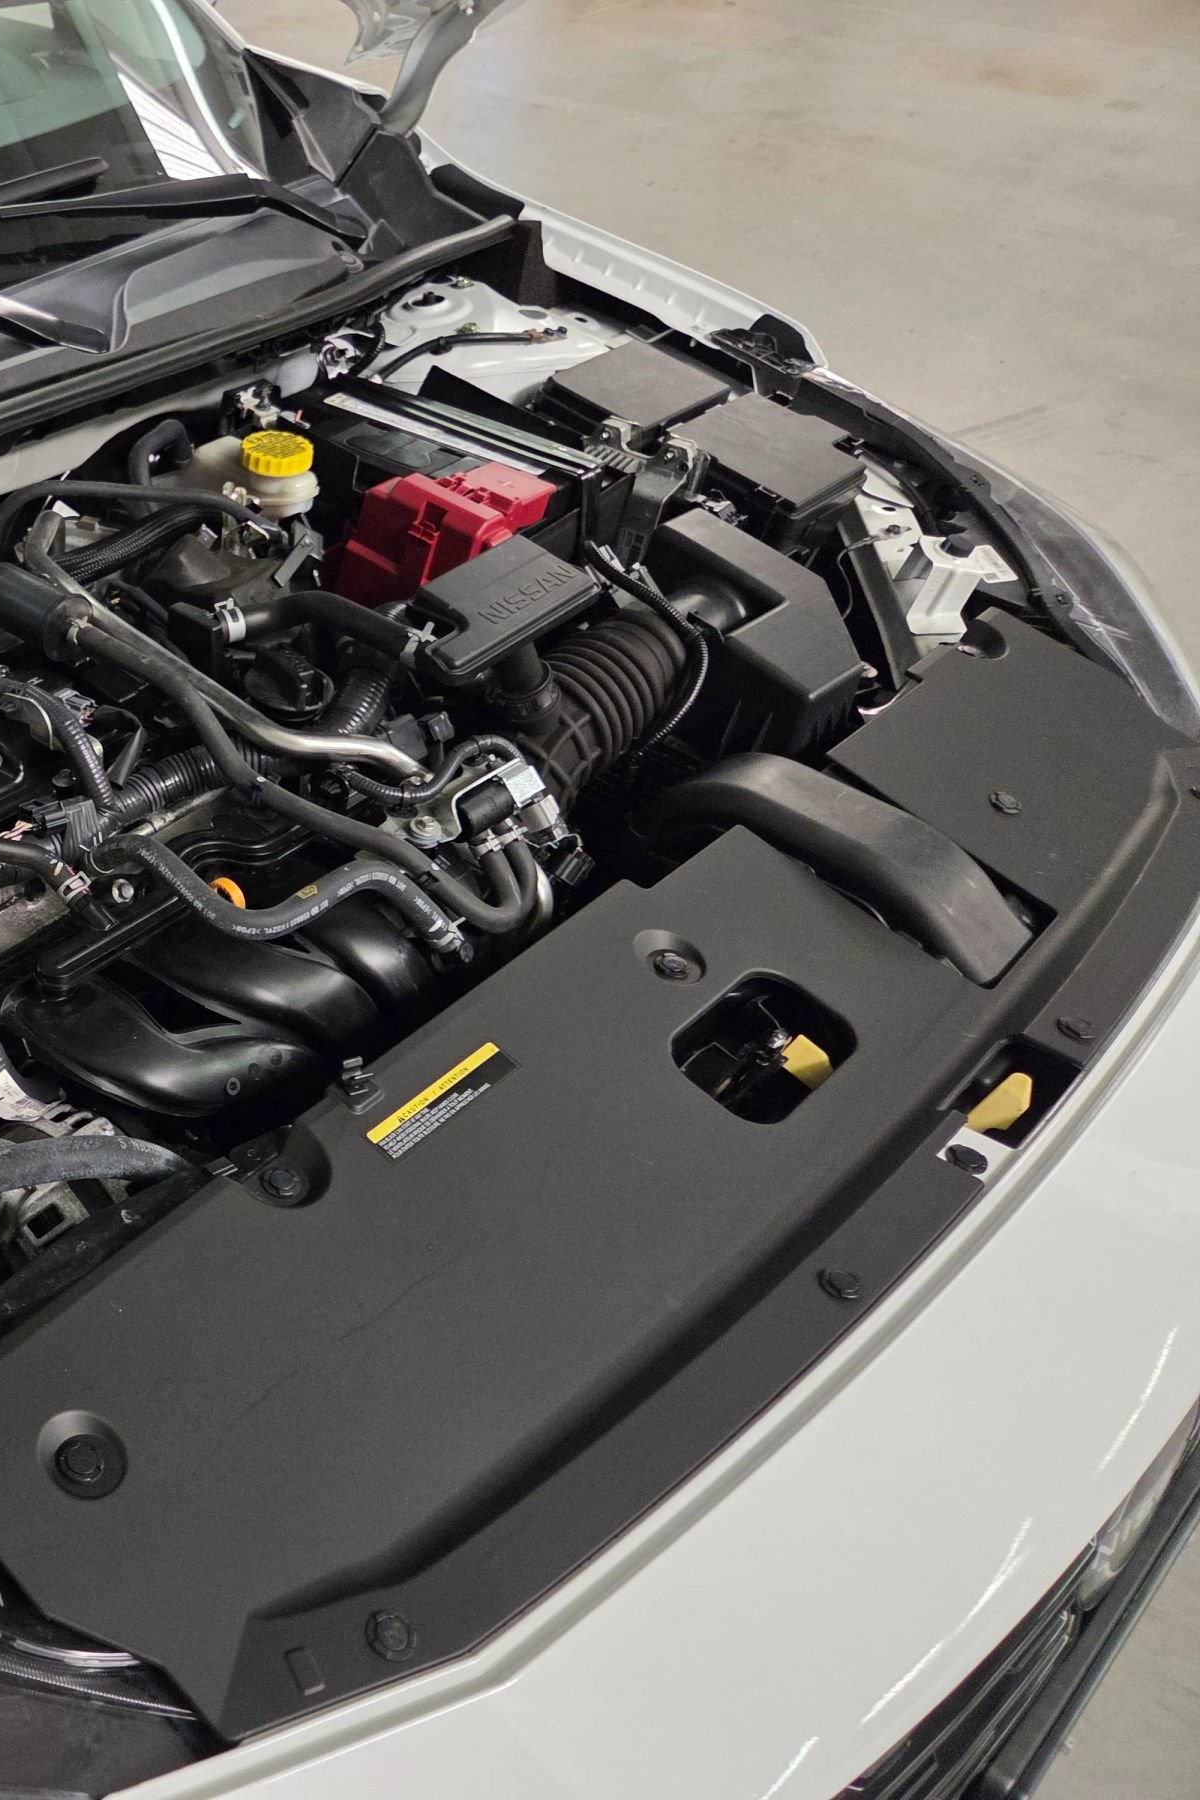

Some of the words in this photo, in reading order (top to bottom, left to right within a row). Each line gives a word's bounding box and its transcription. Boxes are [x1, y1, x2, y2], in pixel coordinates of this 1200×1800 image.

[477, 565, 576, 625] NISSAN
[400, 1096, 429, 1118] CAUTION
[439, 1067, 469, 1091] ATTENTION
